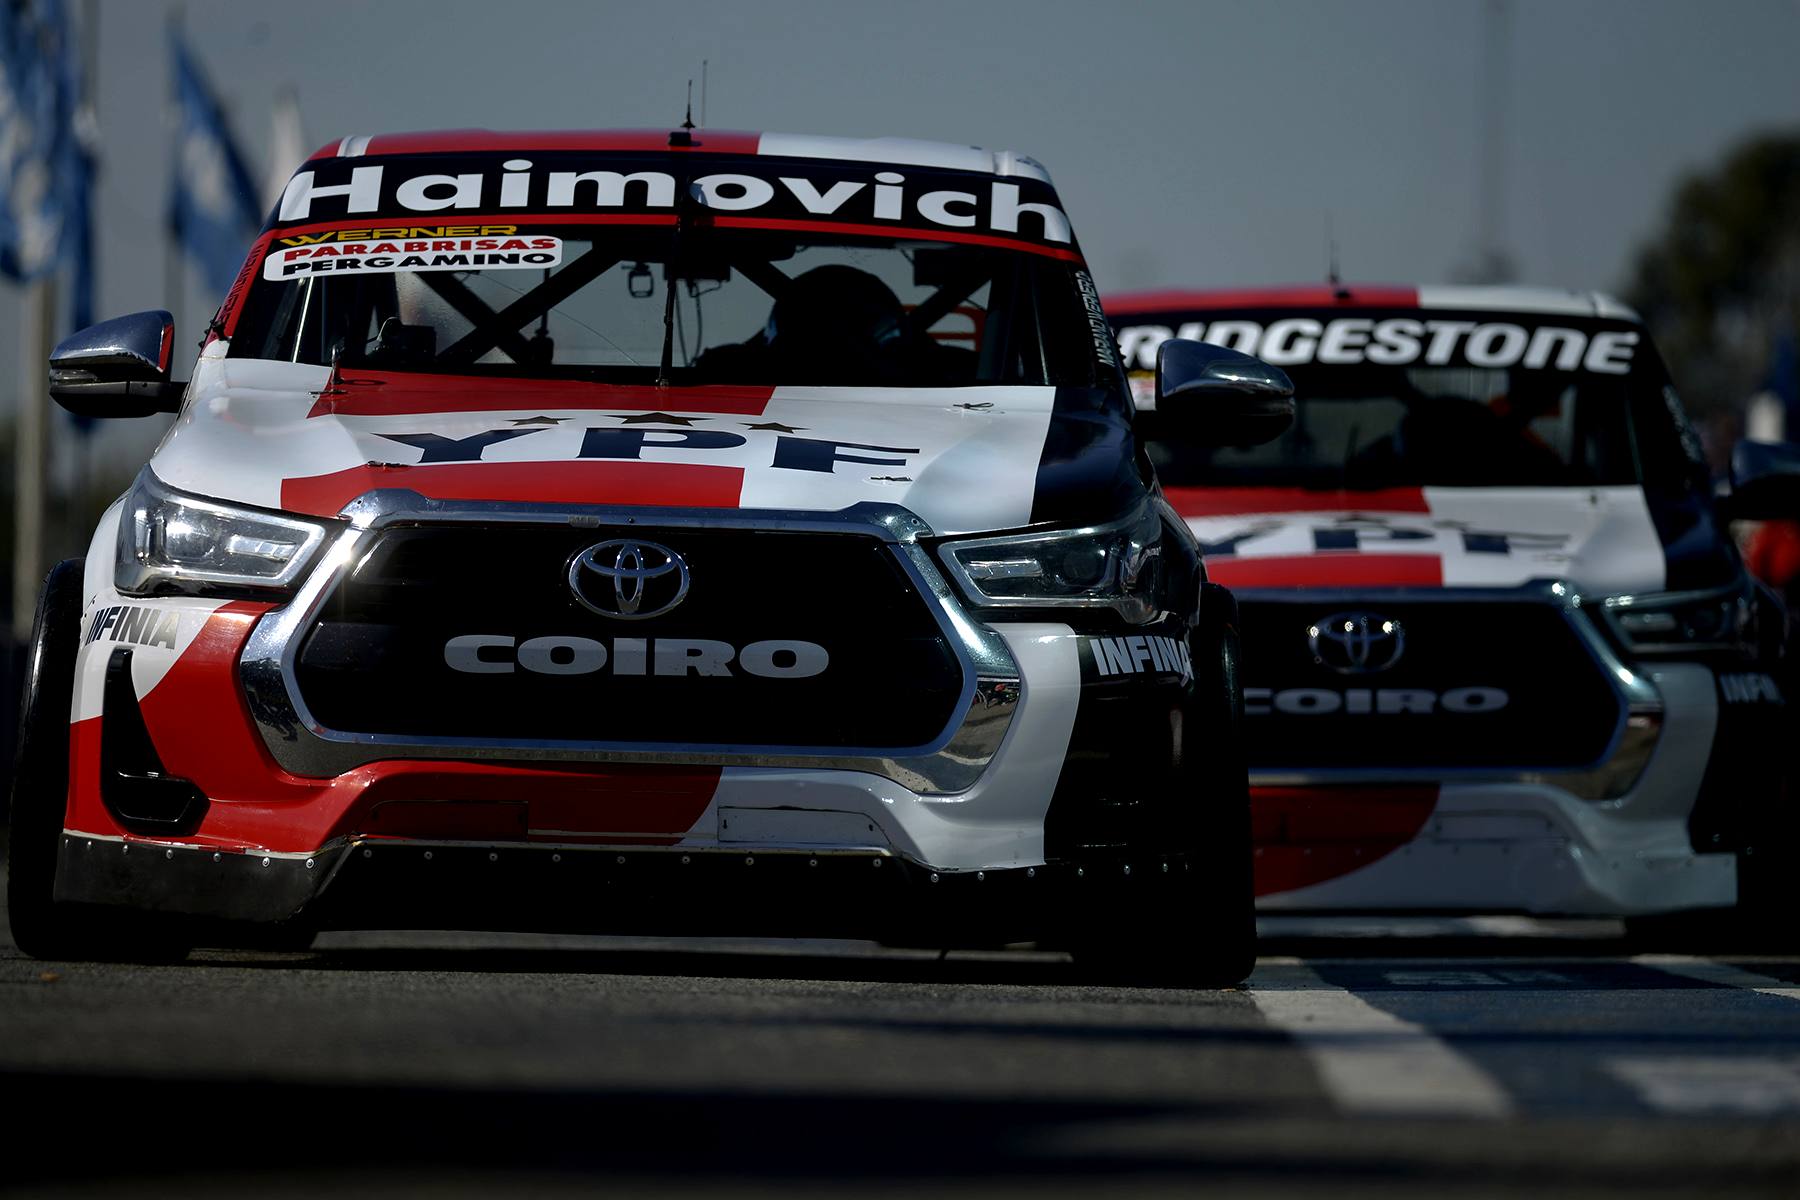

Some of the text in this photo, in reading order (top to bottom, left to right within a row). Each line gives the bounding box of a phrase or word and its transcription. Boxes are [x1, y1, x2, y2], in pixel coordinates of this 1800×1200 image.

[278, 159, 1073, 244] Haimovich
[280, 225, 517, 247] WERNER
[284, 238, 556, 262] PARABRISAS
[283, 253, 556, 276] PERGAMINO
[1117, 318, 1640, 376] RDGESTONE
[370, 427, 921, 474] YPF
[85, 606, 182, 650] INFINIA
[444, 635, 829, 678] COIRO
